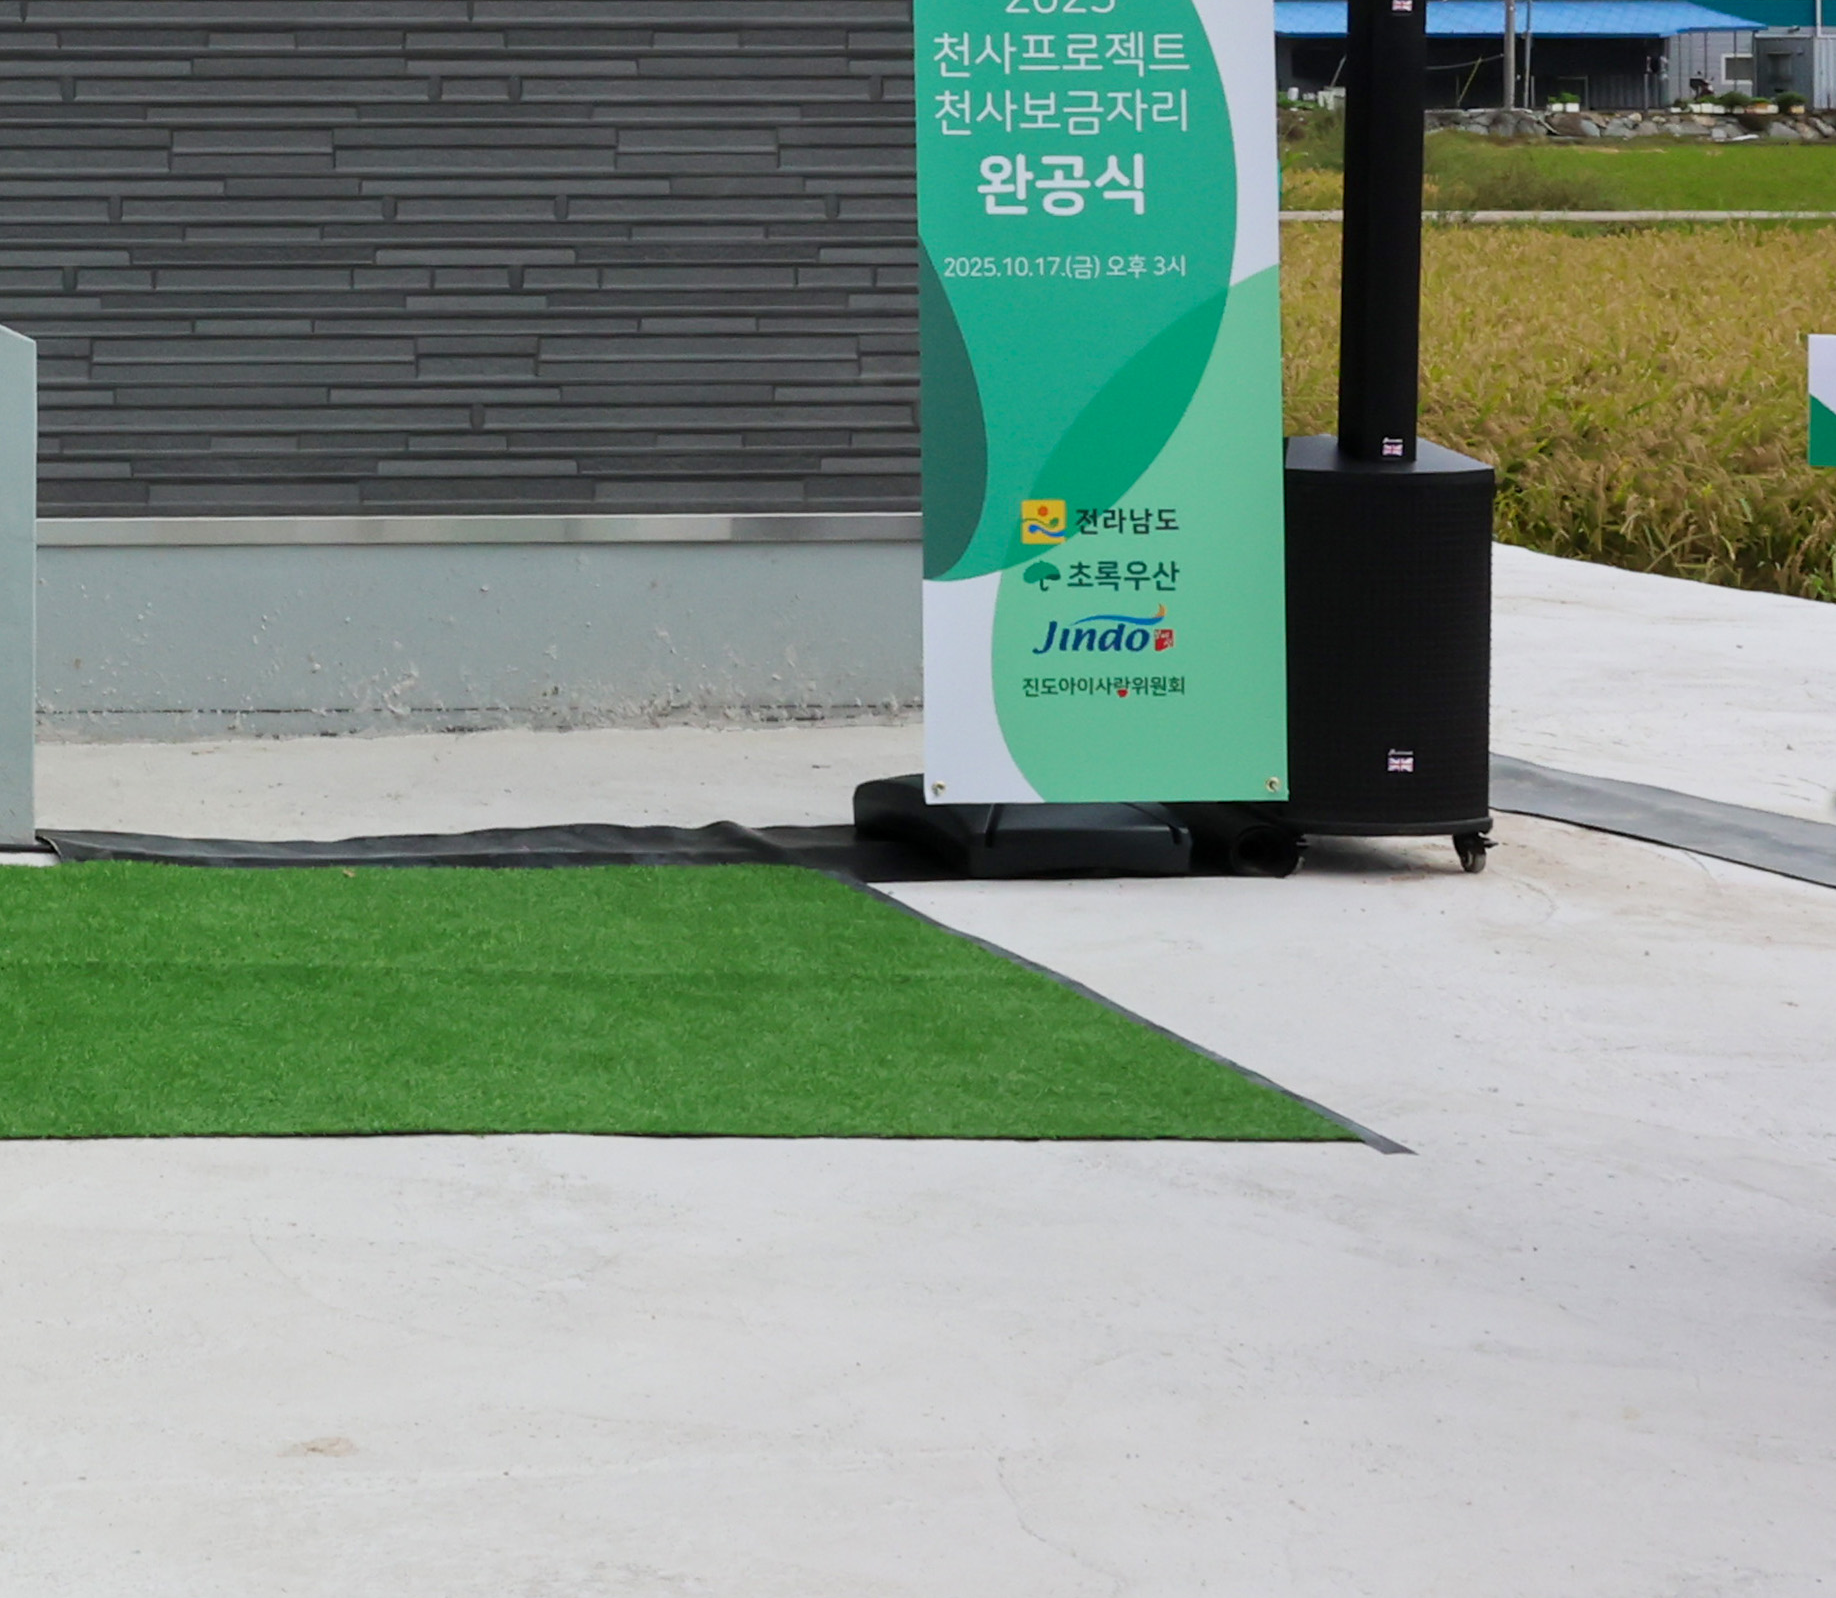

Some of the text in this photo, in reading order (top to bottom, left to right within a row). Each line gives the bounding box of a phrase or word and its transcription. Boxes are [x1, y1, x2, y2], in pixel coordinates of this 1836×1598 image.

[933, 31, 1191, 78] 천사프로젝트
[934, 88, 1188, 136] 천사보금자리
[977, 153, 1145, 217] 완공식
[943, 254, 1186, 280] 2025.10.17.(금) 오후 3시
[1075, 509, 1179, 535] 전라남도
[1066, 560, 1181, 592] 초록우산
[1032, 620, 1150, 654] Jindo
[1022, 676, 1185, 698] 진도아이사랑위원회
